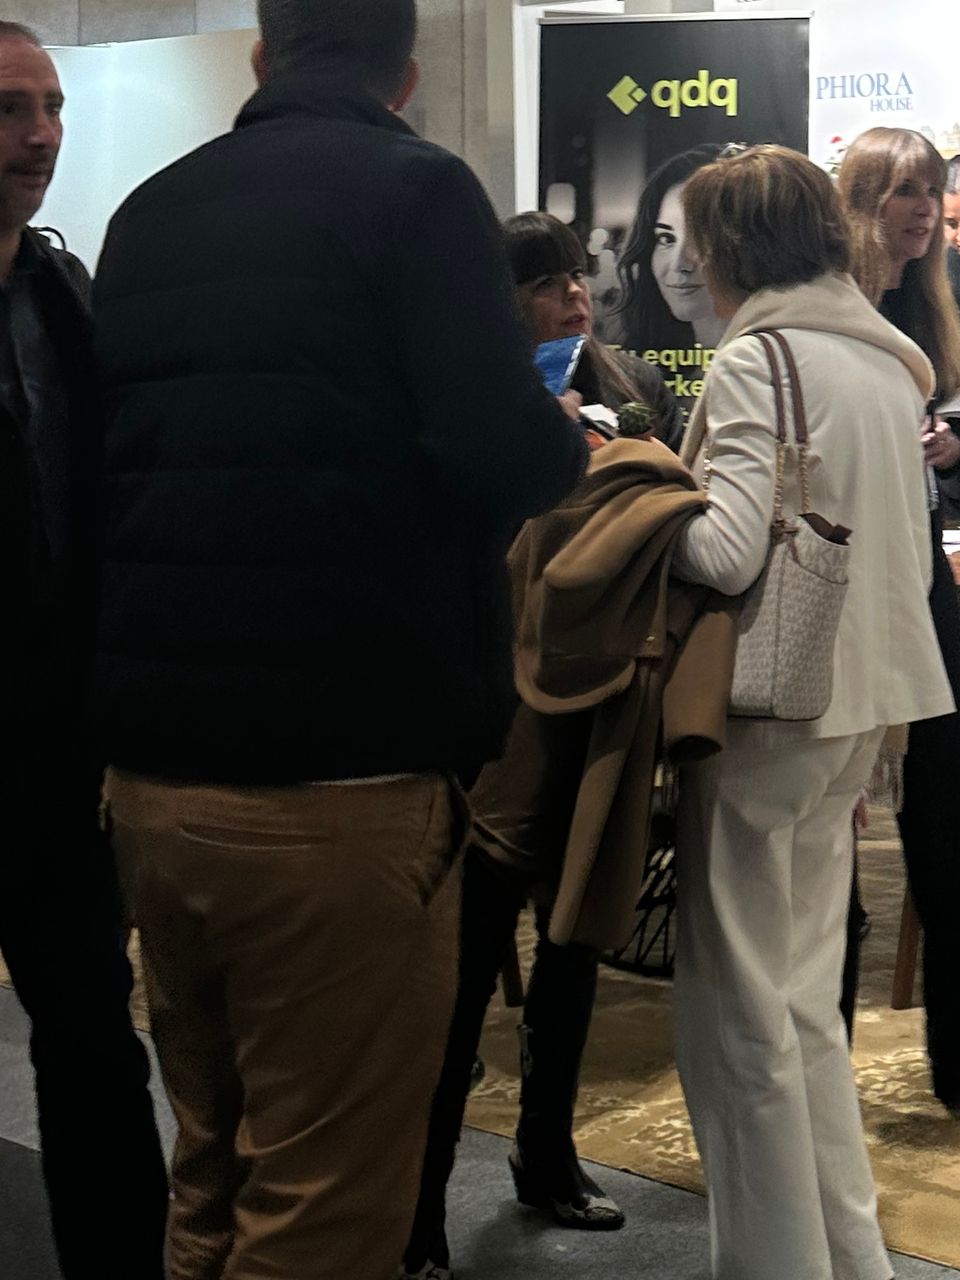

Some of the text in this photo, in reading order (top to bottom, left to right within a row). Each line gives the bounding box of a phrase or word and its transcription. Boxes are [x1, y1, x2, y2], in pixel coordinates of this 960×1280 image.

[651, 70, 738, 117] qdq
[815, 72, 914, 100] PHIORA
[870, 97, 913, 113] HOUSE
[642, 343, 718, 372] equip
